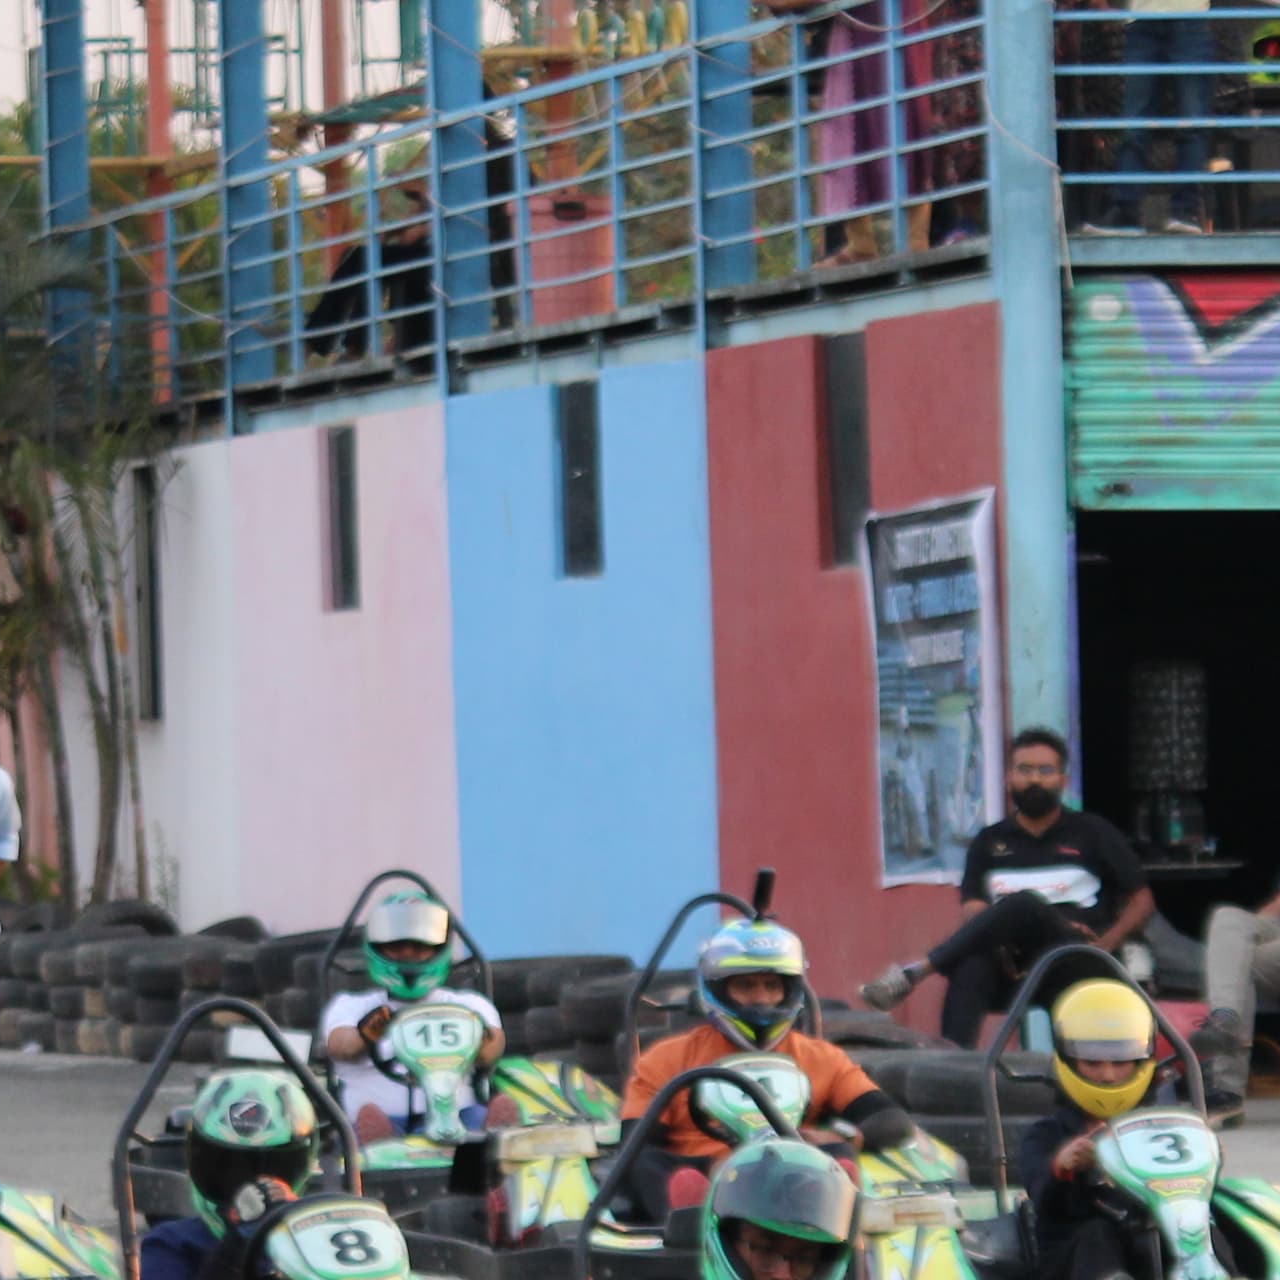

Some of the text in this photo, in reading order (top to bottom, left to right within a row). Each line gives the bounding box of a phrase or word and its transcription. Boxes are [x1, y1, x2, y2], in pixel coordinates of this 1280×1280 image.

[416, 1022, 461, 1048] 15
[1149, 1131, 1195, 1165] 3
[329, 1228, 381, 1266] 8
